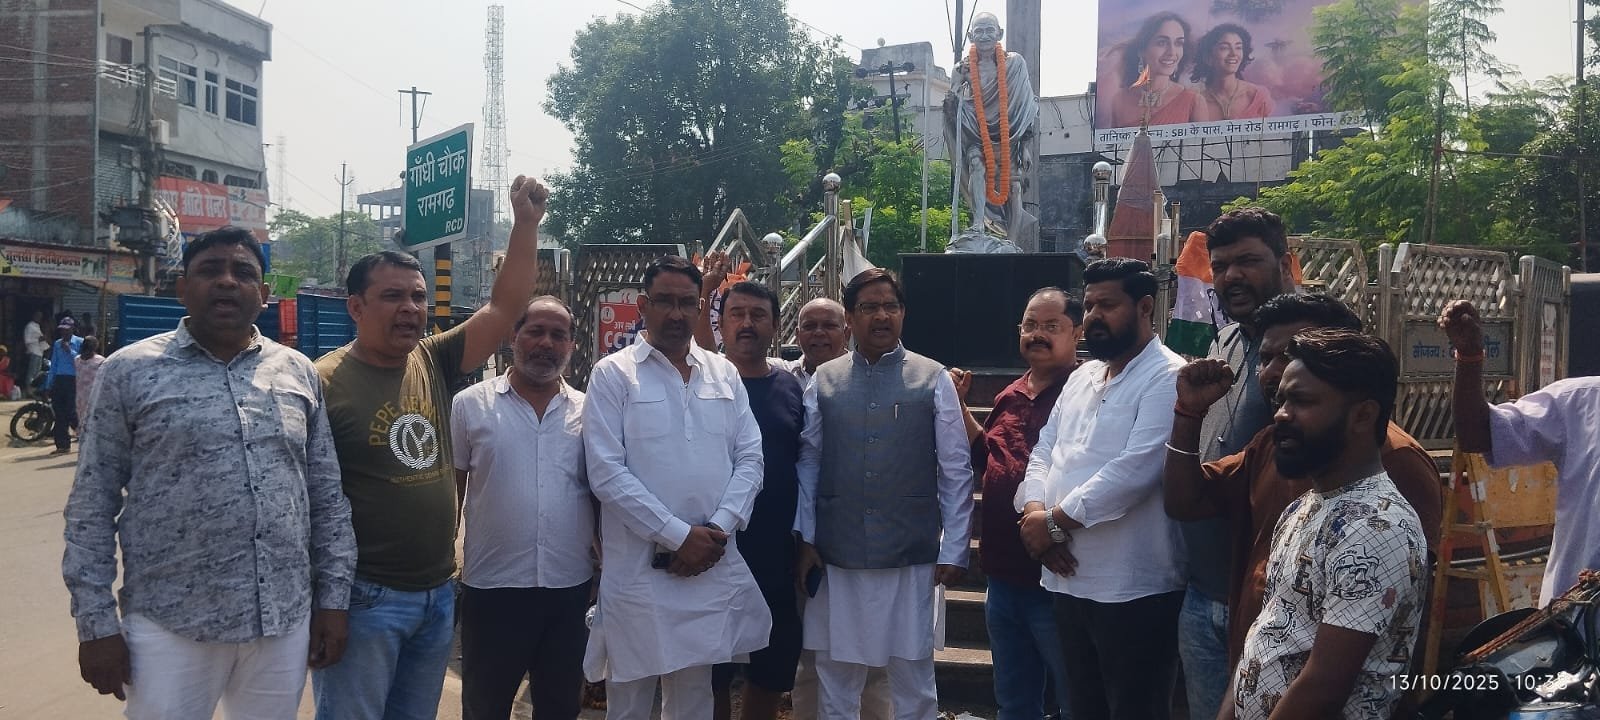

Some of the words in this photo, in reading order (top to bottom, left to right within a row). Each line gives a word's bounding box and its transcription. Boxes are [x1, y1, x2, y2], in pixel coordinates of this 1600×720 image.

[1171, 128, 1187, 137] SBI
[1189, 124, 1200, 135] के
[1226, 122, 1241, 133] मेन
[1267, 119, 1300, 131] रामगढ़
[409, 151, 436, 188] गाँधी
[437, 145, 466, 178] चौक
[417, 187, 456, 217] रामगढ़
[445, 217, 463, 233] RCD
[603, 330, 637, 349] CCT
[368, 400, 400, 447] PEPE
